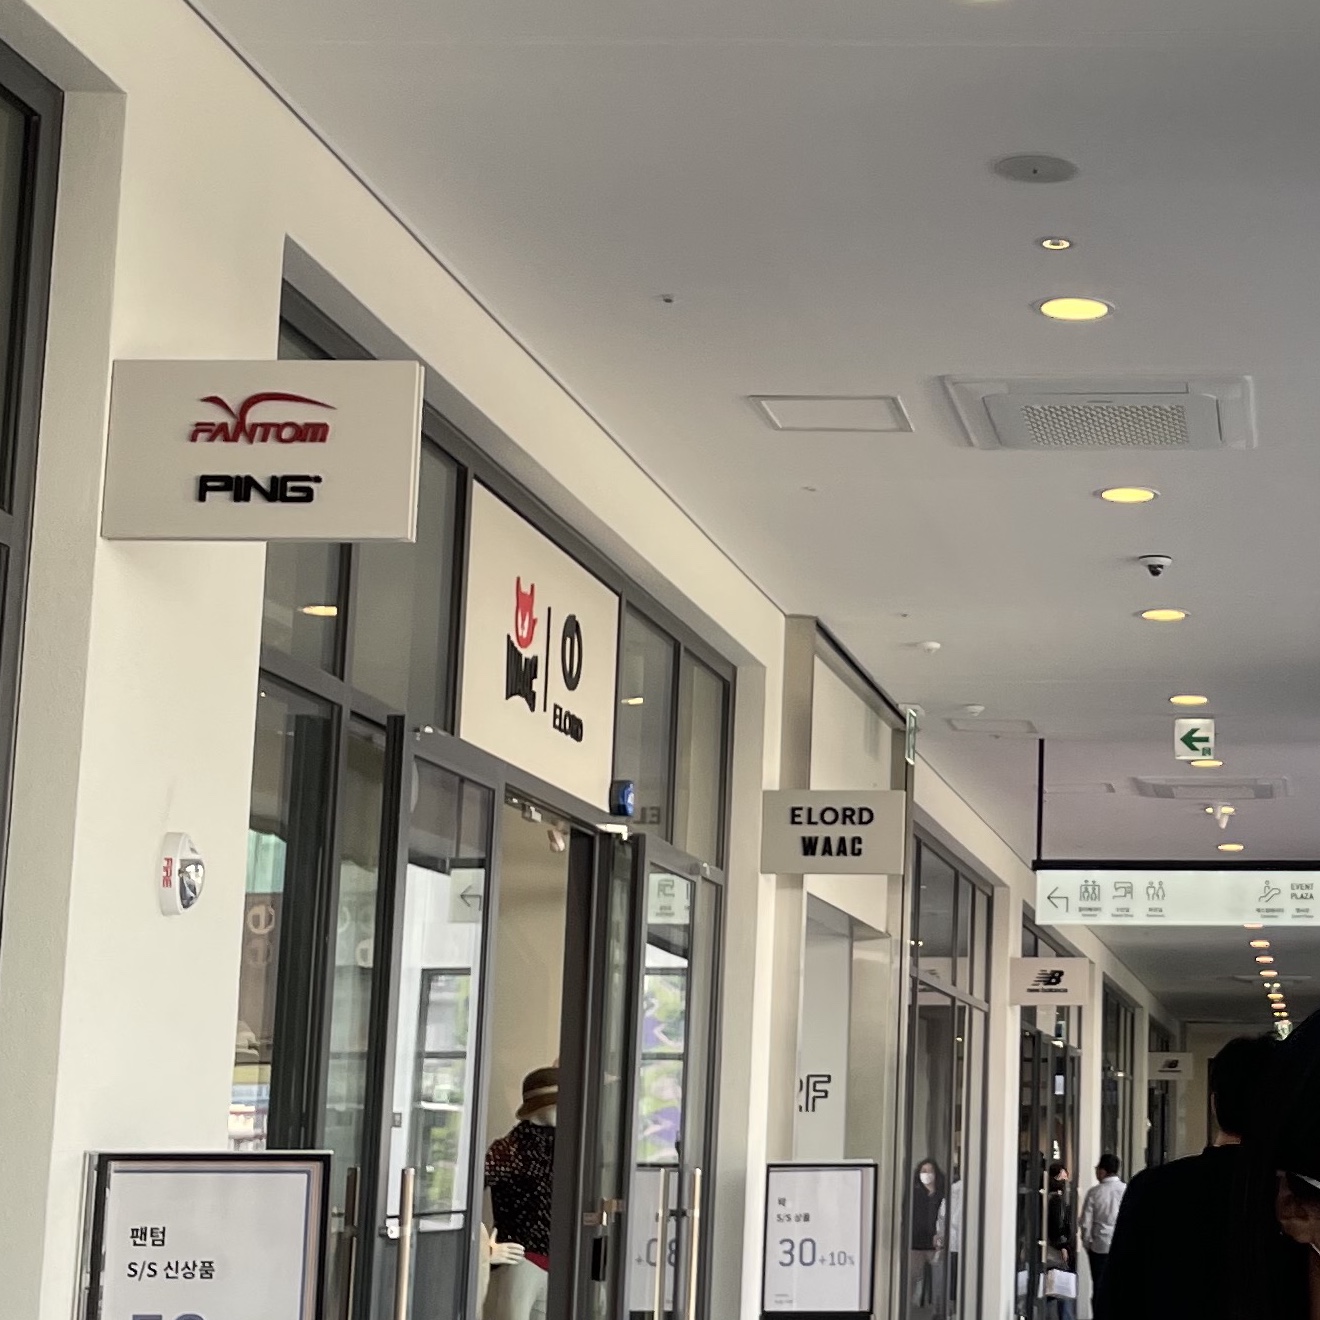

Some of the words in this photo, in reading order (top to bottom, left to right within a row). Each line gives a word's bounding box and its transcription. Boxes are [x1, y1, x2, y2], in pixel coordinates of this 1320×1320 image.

[190, 419, 330, 445] FANTOM
[198, 474, 322, 502] PING
[790, 806, 874, 825] ELORD
[801, 836, 862, 856] WAAC
[130, 1226, 166, 1247] 팬텀
[127, 1260, 158, 1281] S/S
[163, 1259, 215, 1280] 신상품
